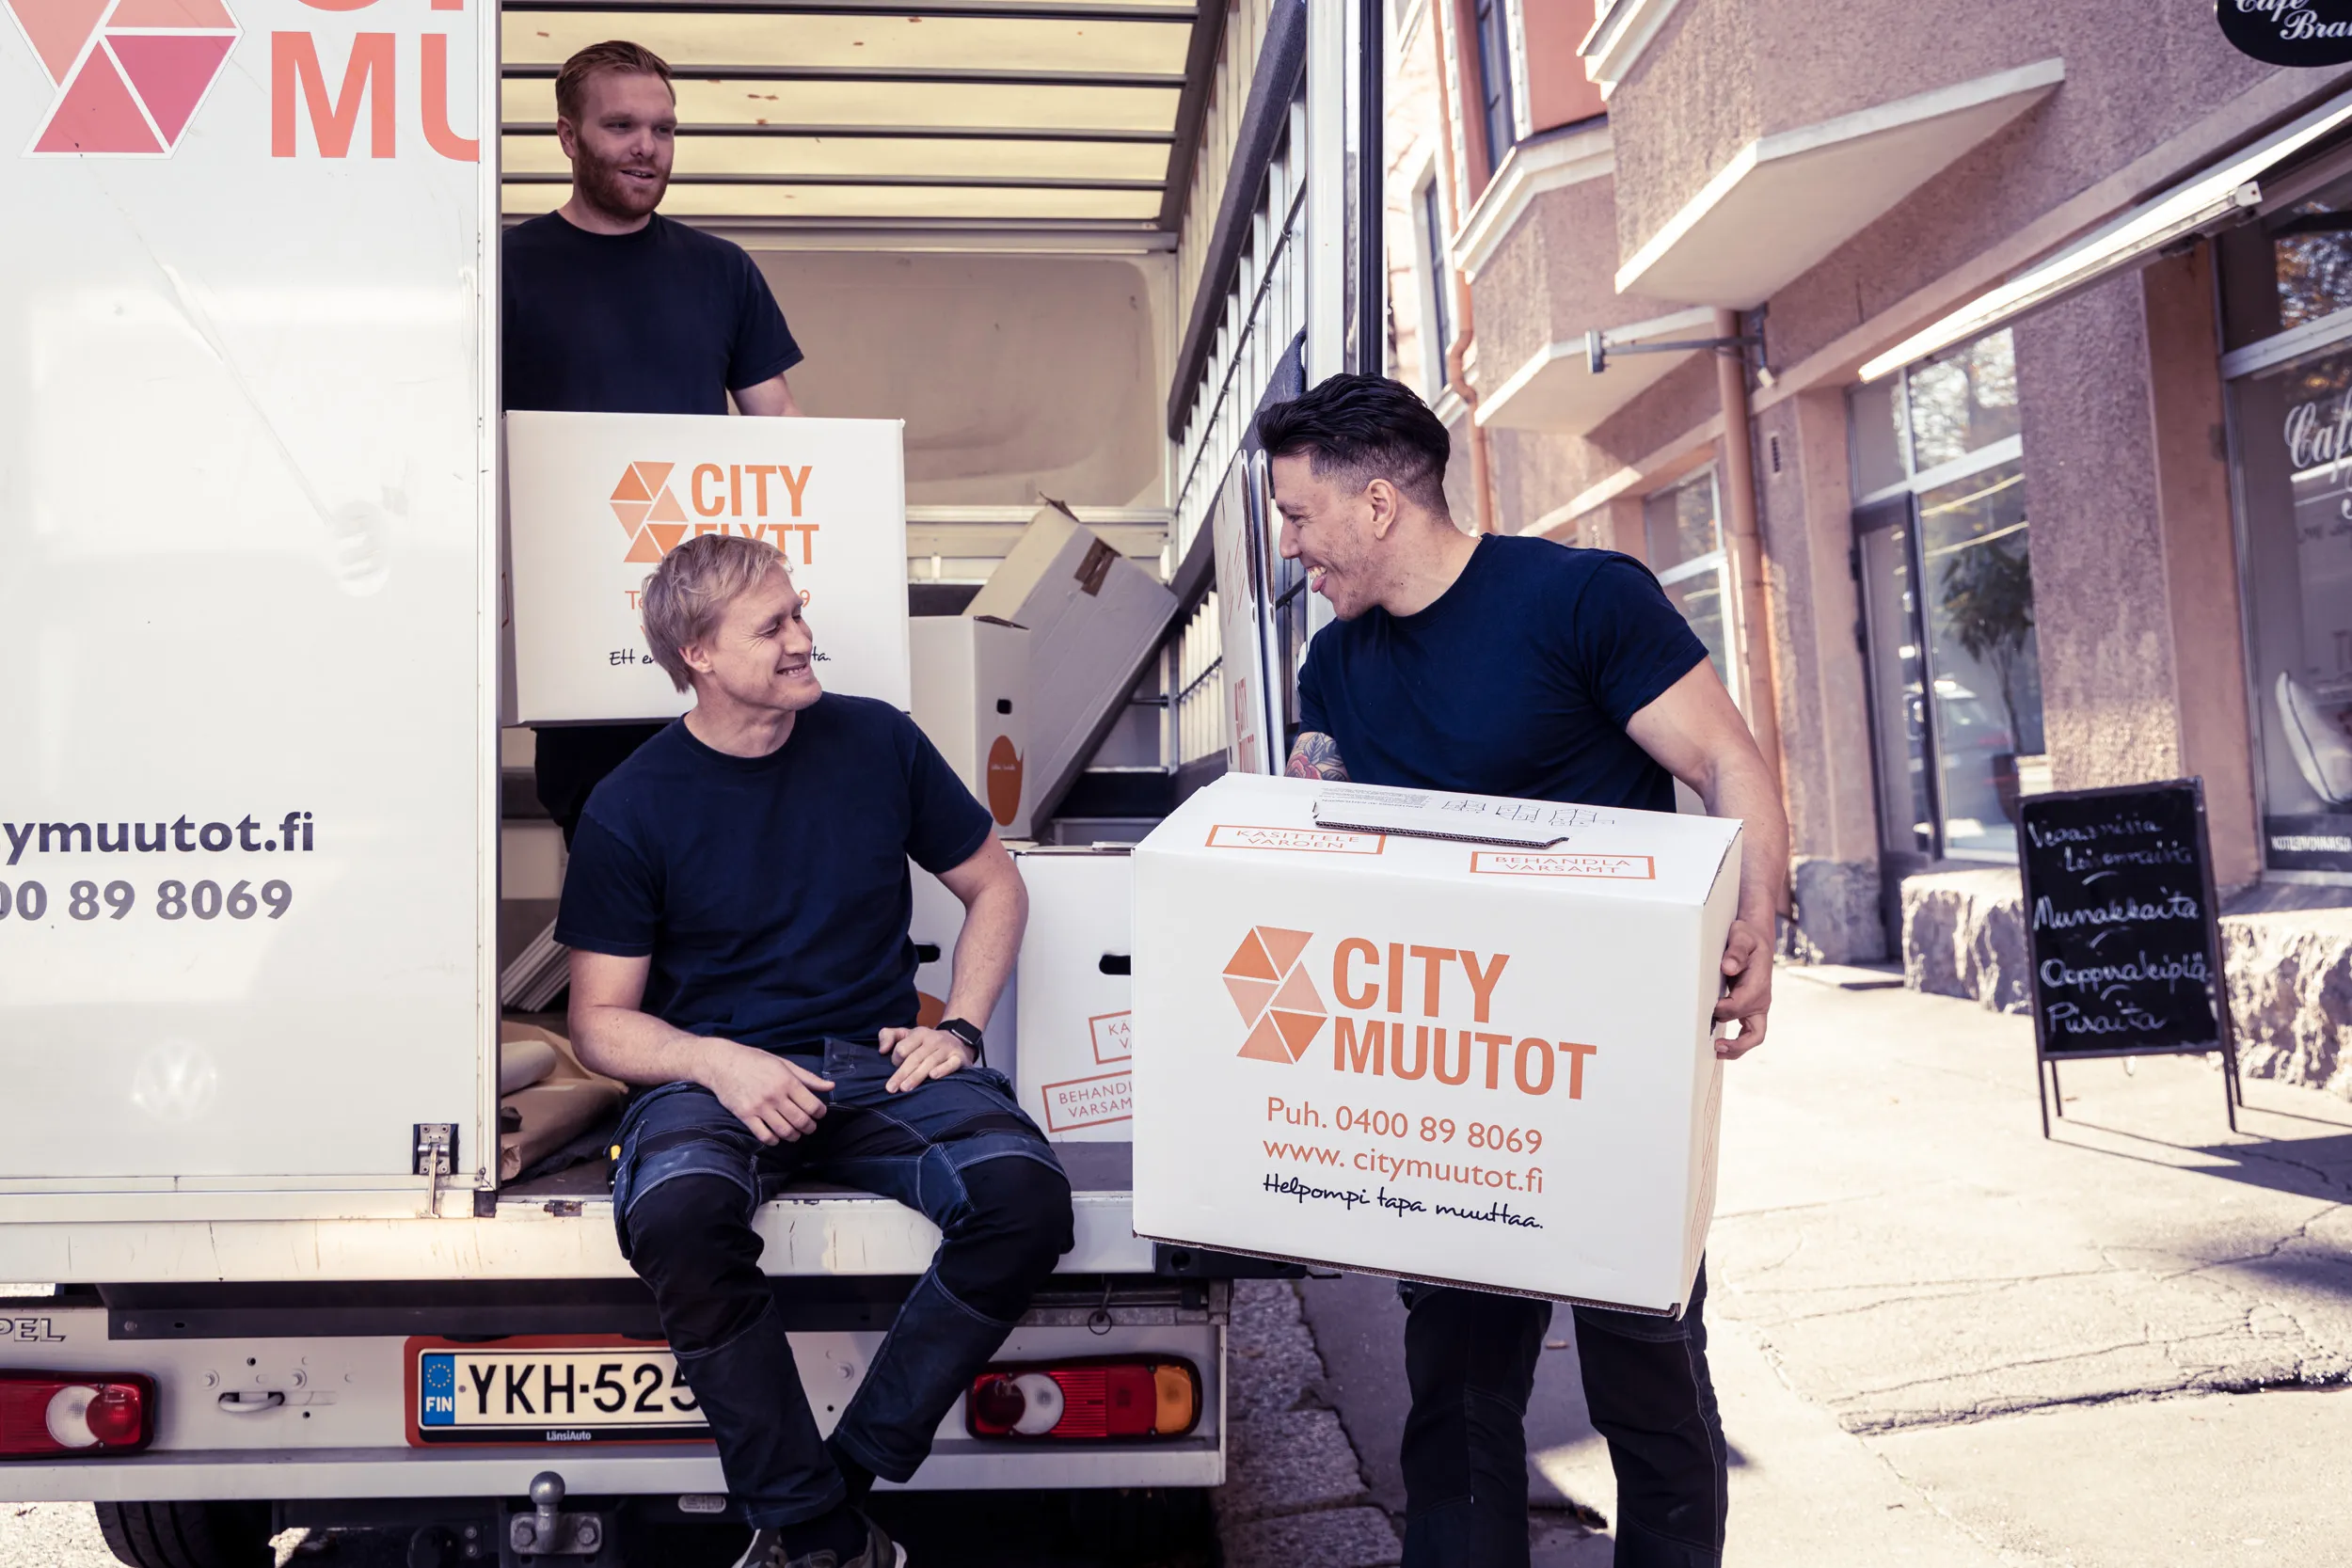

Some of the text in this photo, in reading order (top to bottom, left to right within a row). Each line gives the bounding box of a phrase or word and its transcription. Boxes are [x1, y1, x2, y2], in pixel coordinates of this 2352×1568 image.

[2284, 387, 2352, 483] Caf
[691, 463, 813, 516] CITY
[609, 648, 636, 665] Ett
[3, 812, 314, 865] ymuutot.fi
[1248, 838, 1343, 848] VAROEN
[1495, 857, 1630, 866] BEHANDLA
[1505, 864, 1620, 874] VARSAMT
[69, 879, 135, 921] 89
[156, 879, 293, 921] 8069
[1332, 937, 1510, 1023] CITY
[1333, 1016, 1597, 1100] MUUTOT
[1267, 1097, 1542, 1154] Puh. 0400 89 8069
[1263, 1173, 1543, 1228] Helpompi tapa muuttaa.
[425, 1397, 453, 1412] FIN
[469, 1363, 699, 1414] YKH-525
[547, 1430, 592, 1441] LänsiAuto
